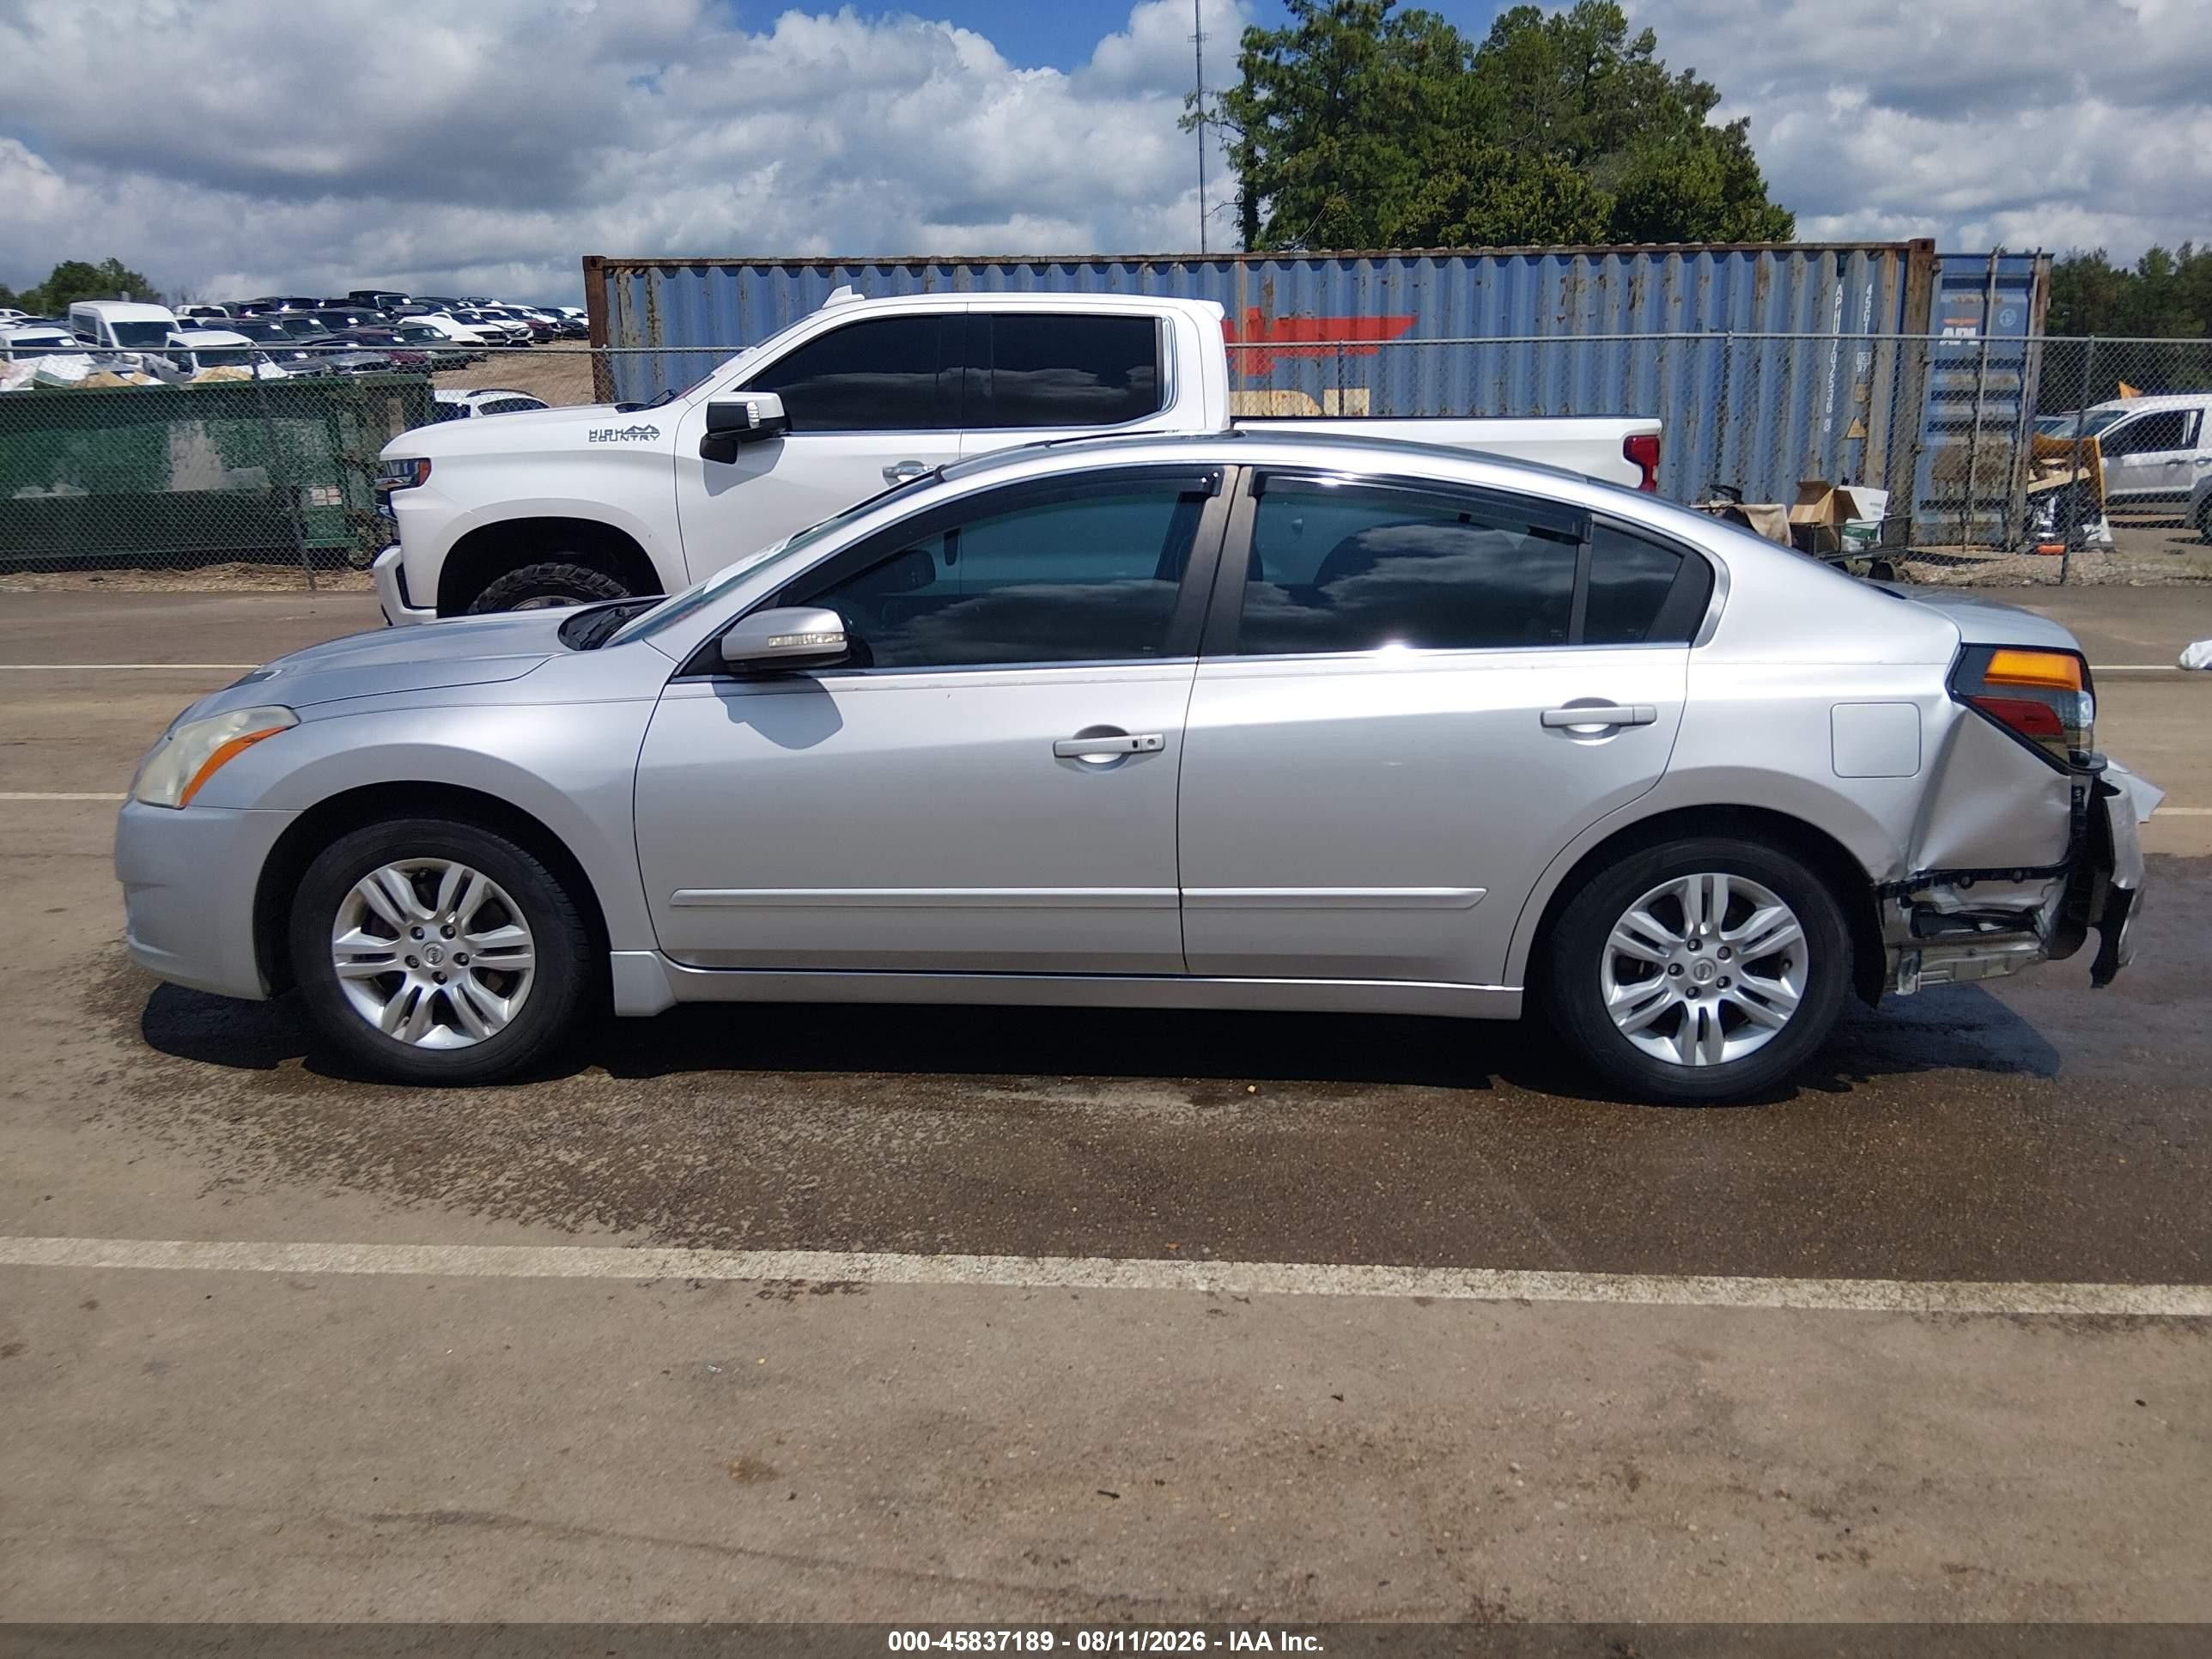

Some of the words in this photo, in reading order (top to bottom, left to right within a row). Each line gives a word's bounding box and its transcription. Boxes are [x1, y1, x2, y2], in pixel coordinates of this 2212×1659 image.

[1833, 284, 1843, 334] APHU
[1938, 327, 1981, 345] APL
[588, 434, 660, 442] COUNTRY
